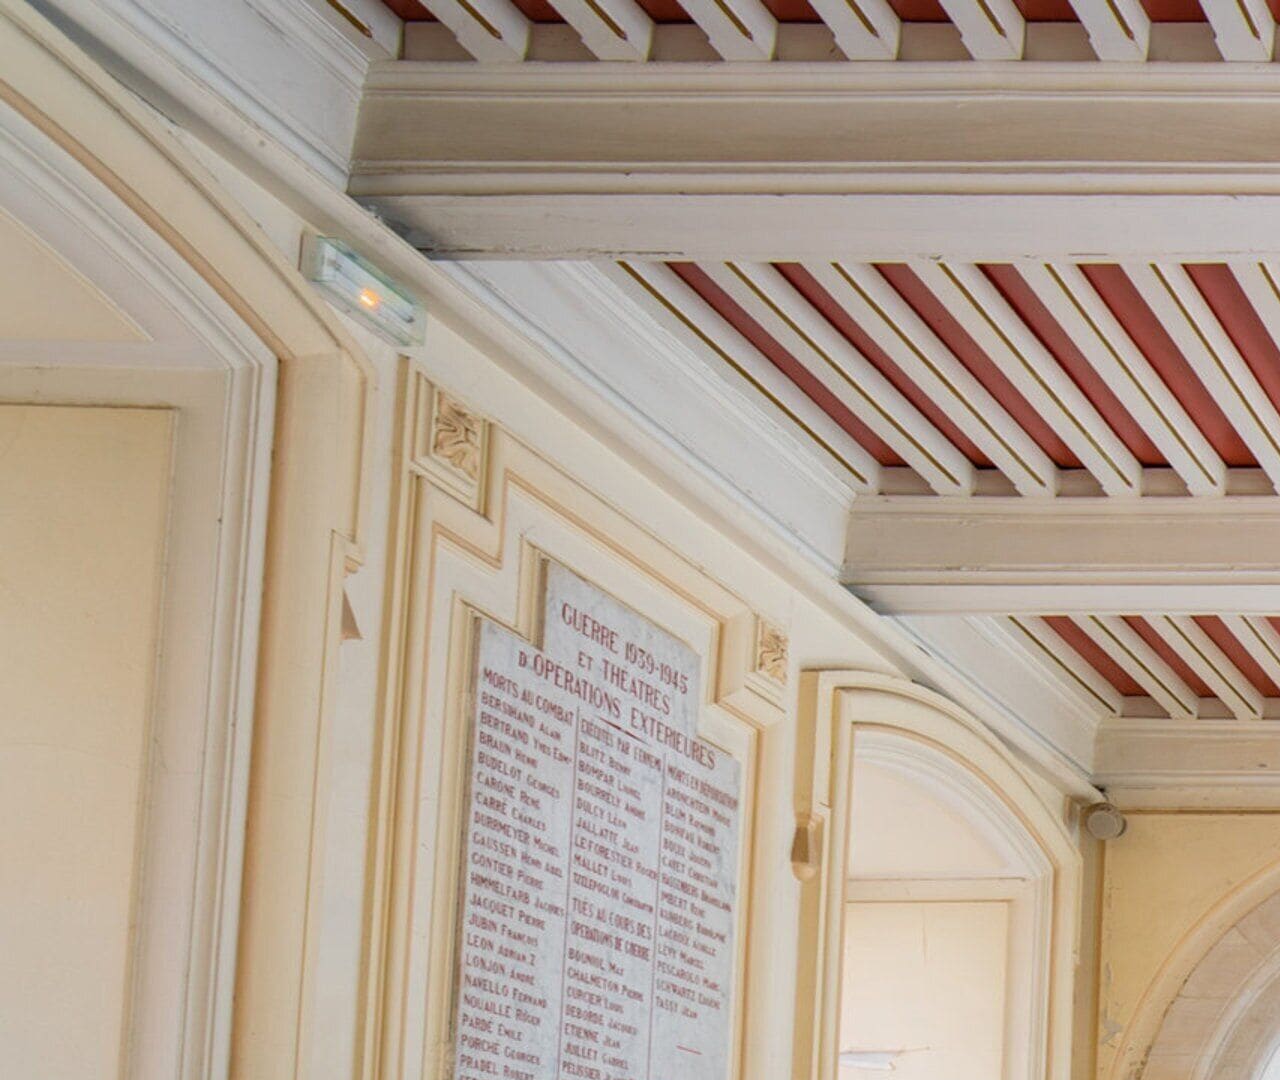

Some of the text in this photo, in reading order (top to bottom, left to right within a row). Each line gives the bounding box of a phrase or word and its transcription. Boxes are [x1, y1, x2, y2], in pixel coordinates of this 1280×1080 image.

[561, 601, 688, 695] GUERRE 1939-1945
[577, 650, 592, 671] ET
[483, 667, 573, 726] MORTS AU COMBAT
[480, 710, 528, 745] BERTRAND
